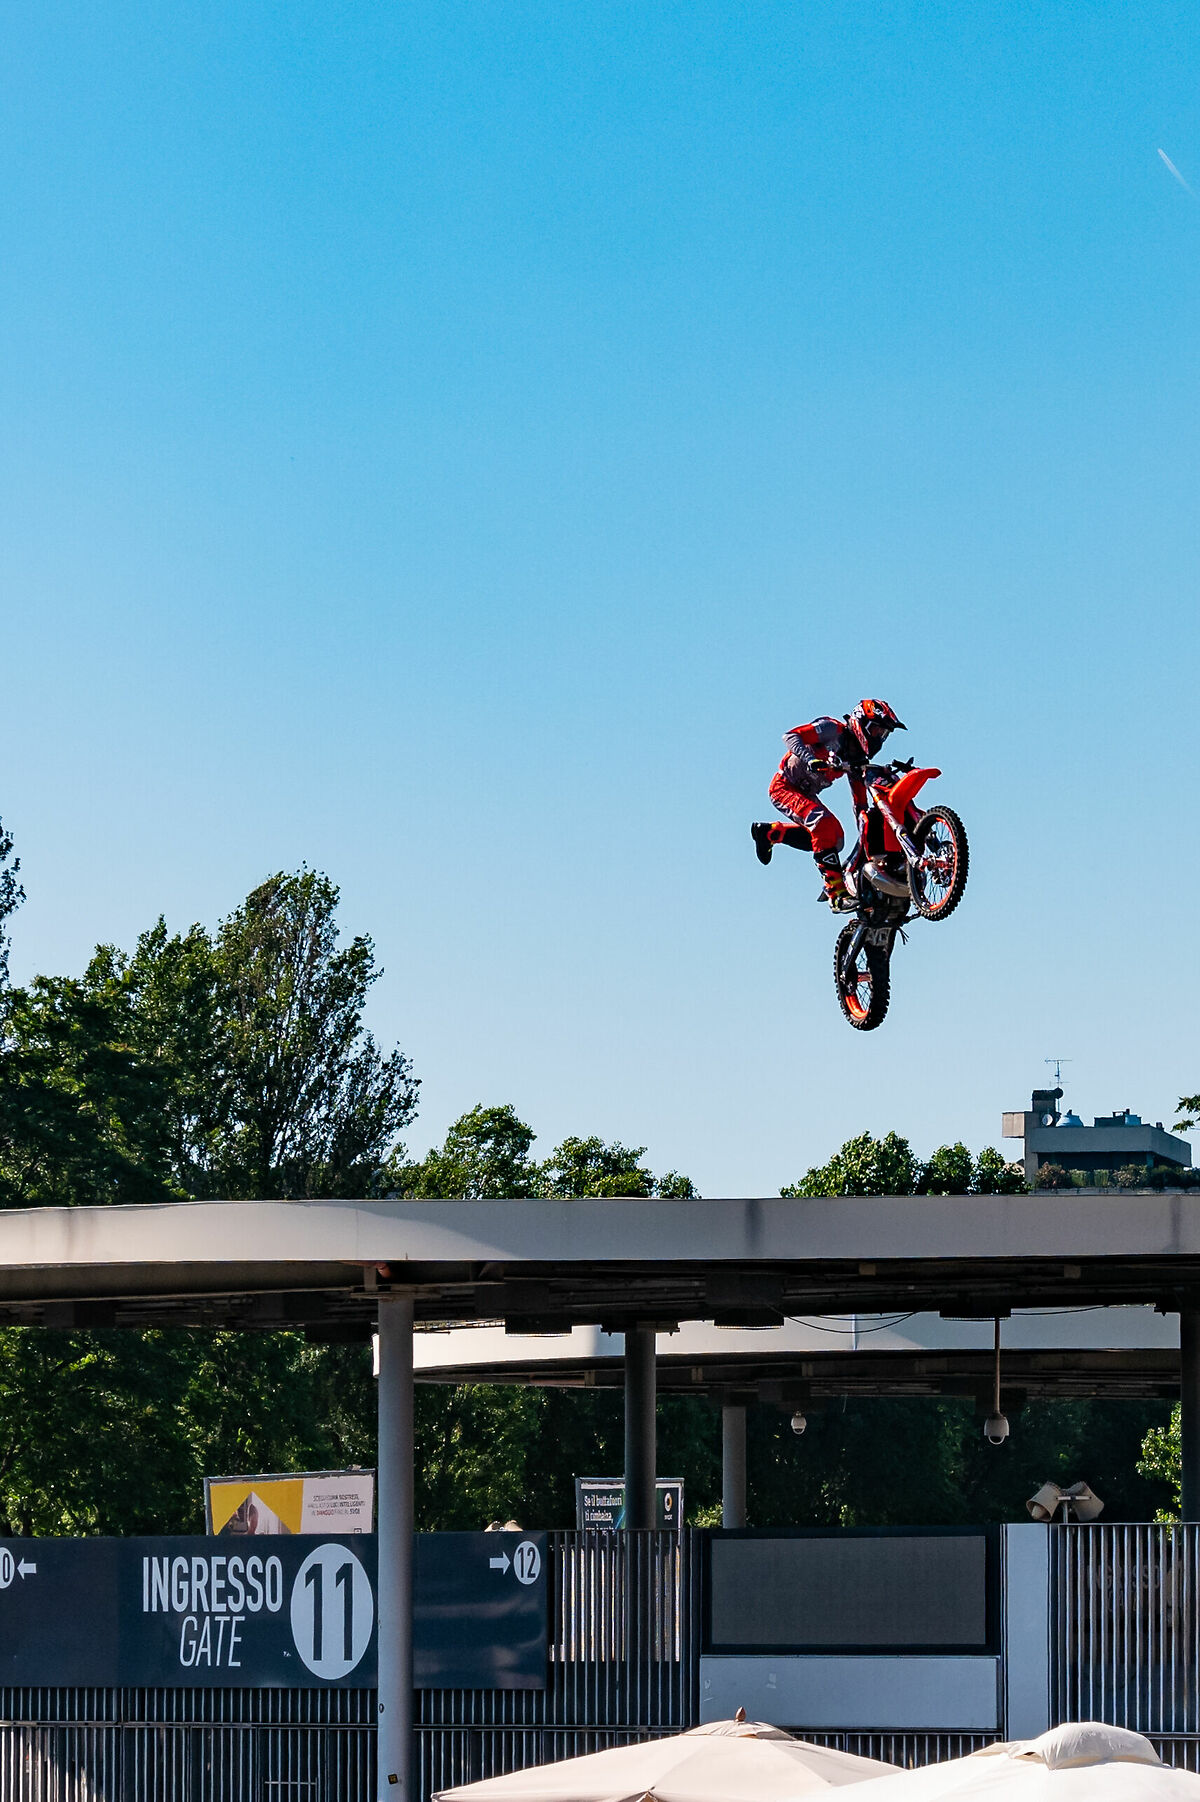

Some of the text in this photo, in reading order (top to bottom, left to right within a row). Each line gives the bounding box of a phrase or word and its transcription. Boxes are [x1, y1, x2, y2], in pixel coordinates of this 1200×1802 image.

[142, 1556, 283, 1613] INGRESSO
[519, 1548, 536, 1578] 12
[304, 1563, 354, 1661] 11
[180, 1615, 246, 1667] GATE
